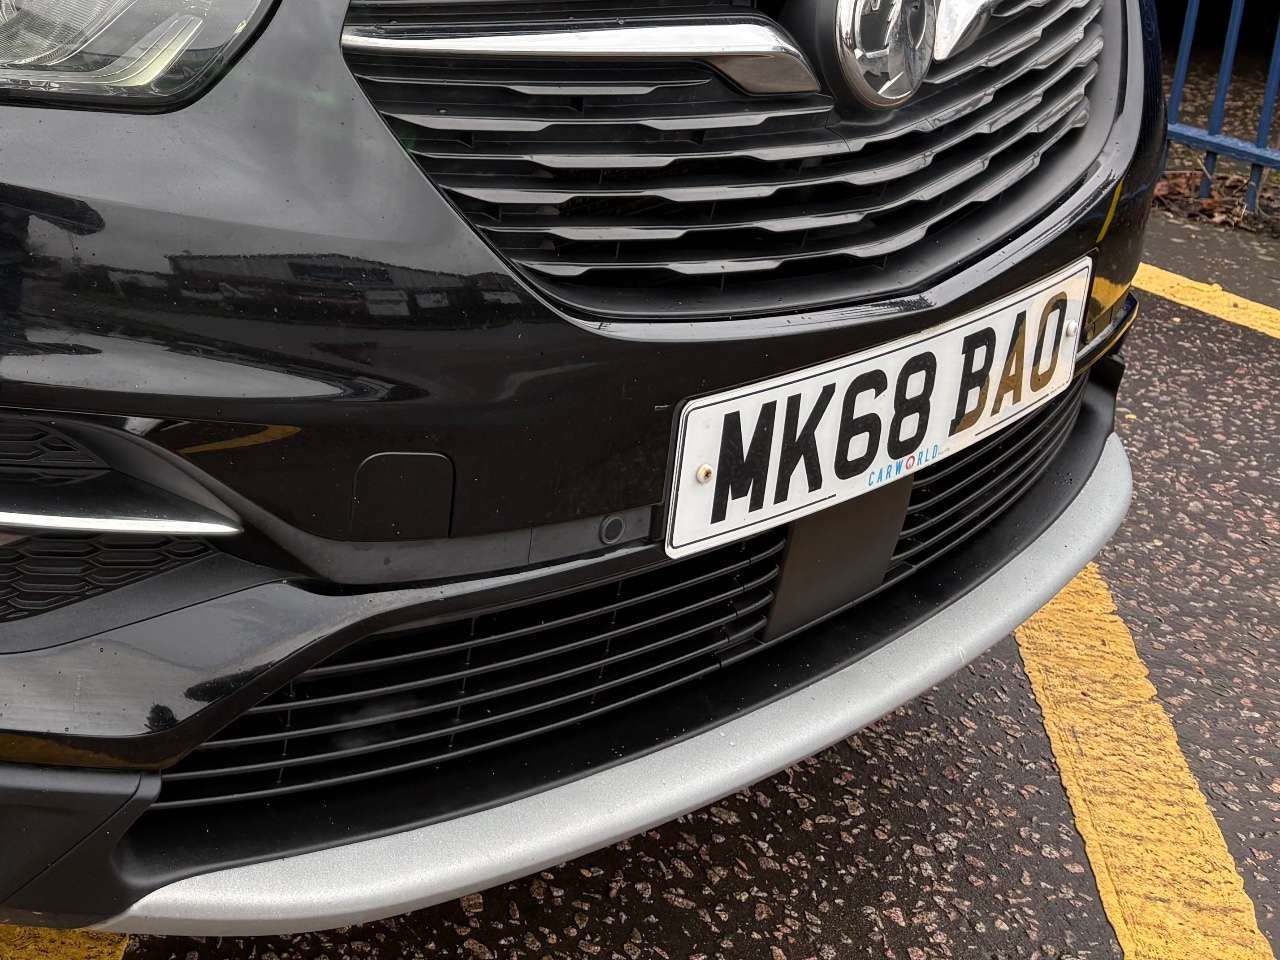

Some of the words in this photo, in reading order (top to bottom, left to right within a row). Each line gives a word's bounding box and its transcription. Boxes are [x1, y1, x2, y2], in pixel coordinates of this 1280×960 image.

[710, 350, 937, 525] MK68
[948, 290, 1069, 438] BAO
[868, 444, 939, 487] CARWORLD
